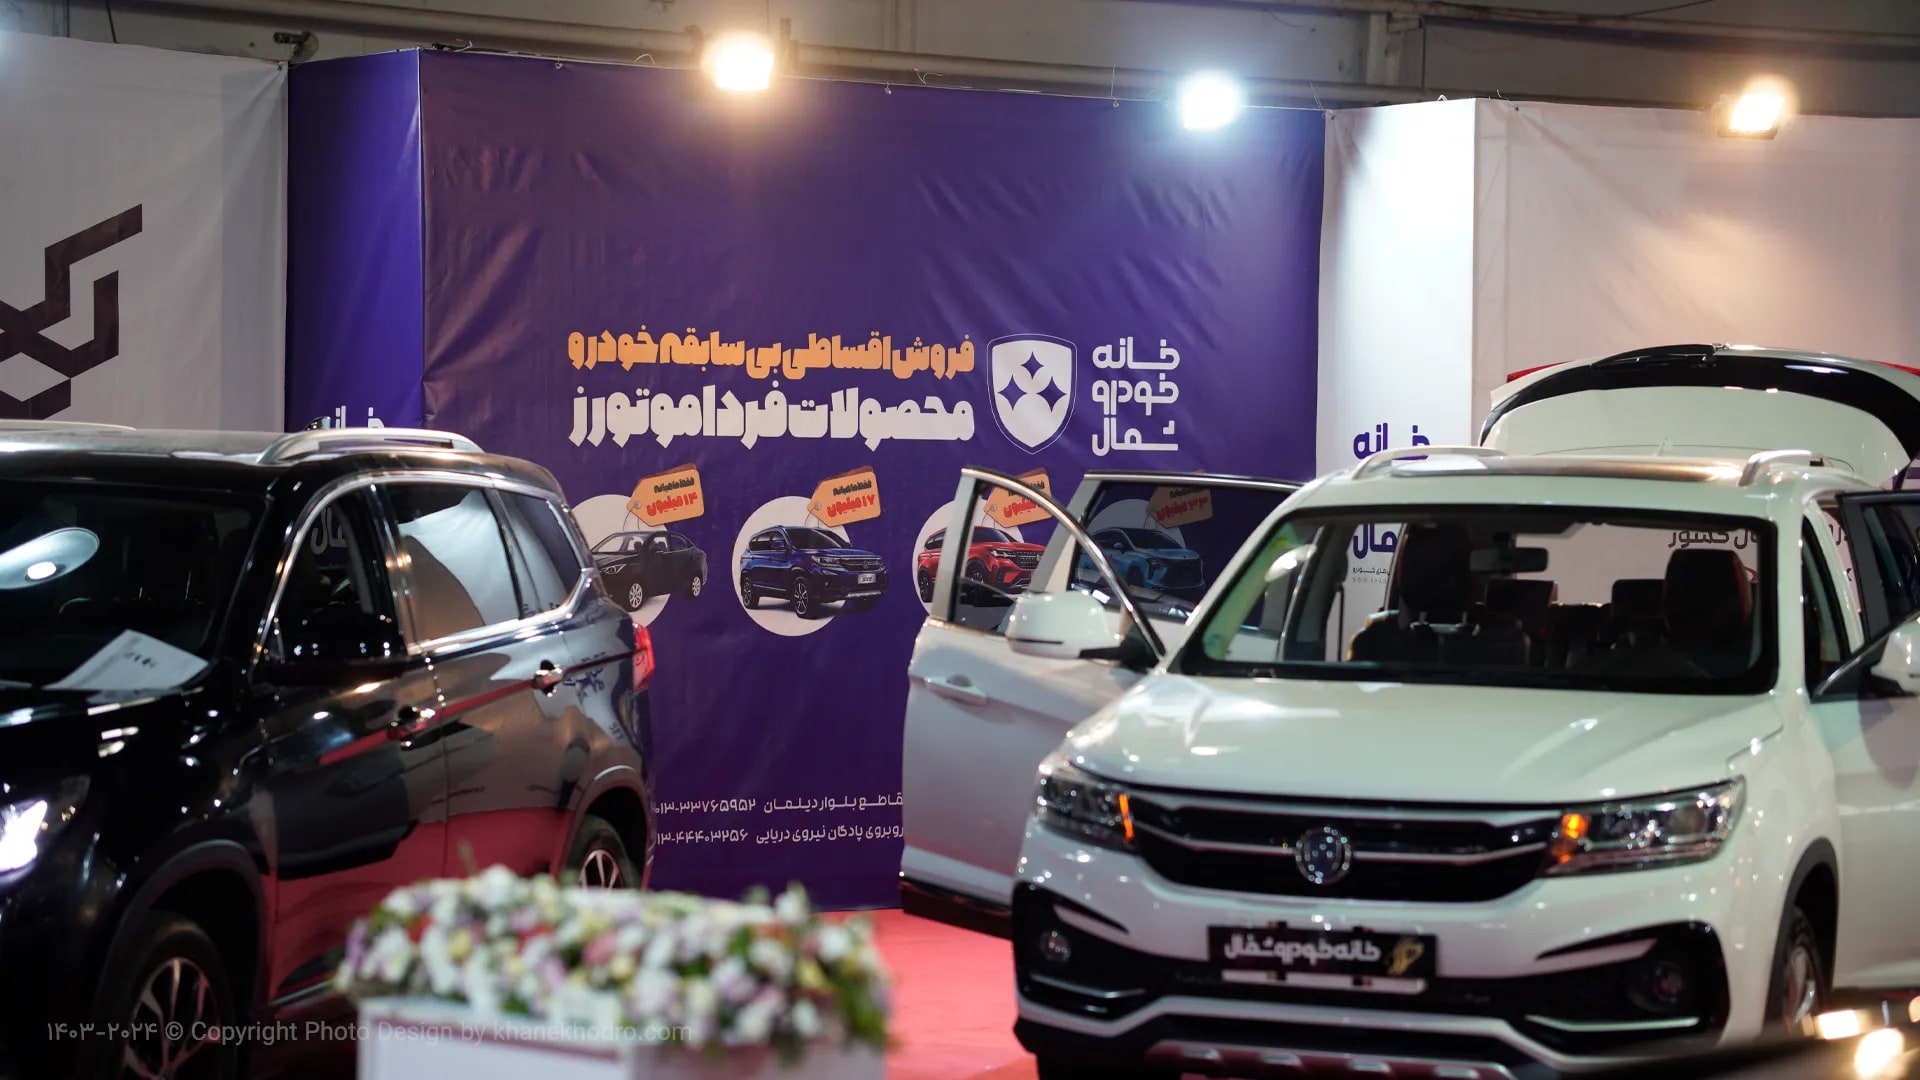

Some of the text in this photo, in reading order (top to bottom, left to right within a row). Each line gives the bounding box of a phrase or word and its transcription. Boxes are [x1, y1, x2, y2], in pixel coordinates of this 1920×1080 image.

[567, 324, 975, 380] فروش اقساطی بی سابقه خودرو
[1092, 336, 1181, 371] خانه
[1091, 372, 1180, 416] خودرو
[568, 379, 975, 452] محصولات فردا موتورز
[1091, 417, 1179, 457] شمال
[646, 495, 684, 517] میلیون
[826, 494, 875, 518] ۱۷ میلیون
[1353, 522, 1398, 560] مال
[656, 828, 749, 845] ۱۳-۴۴۴۰۳۲۵۶
